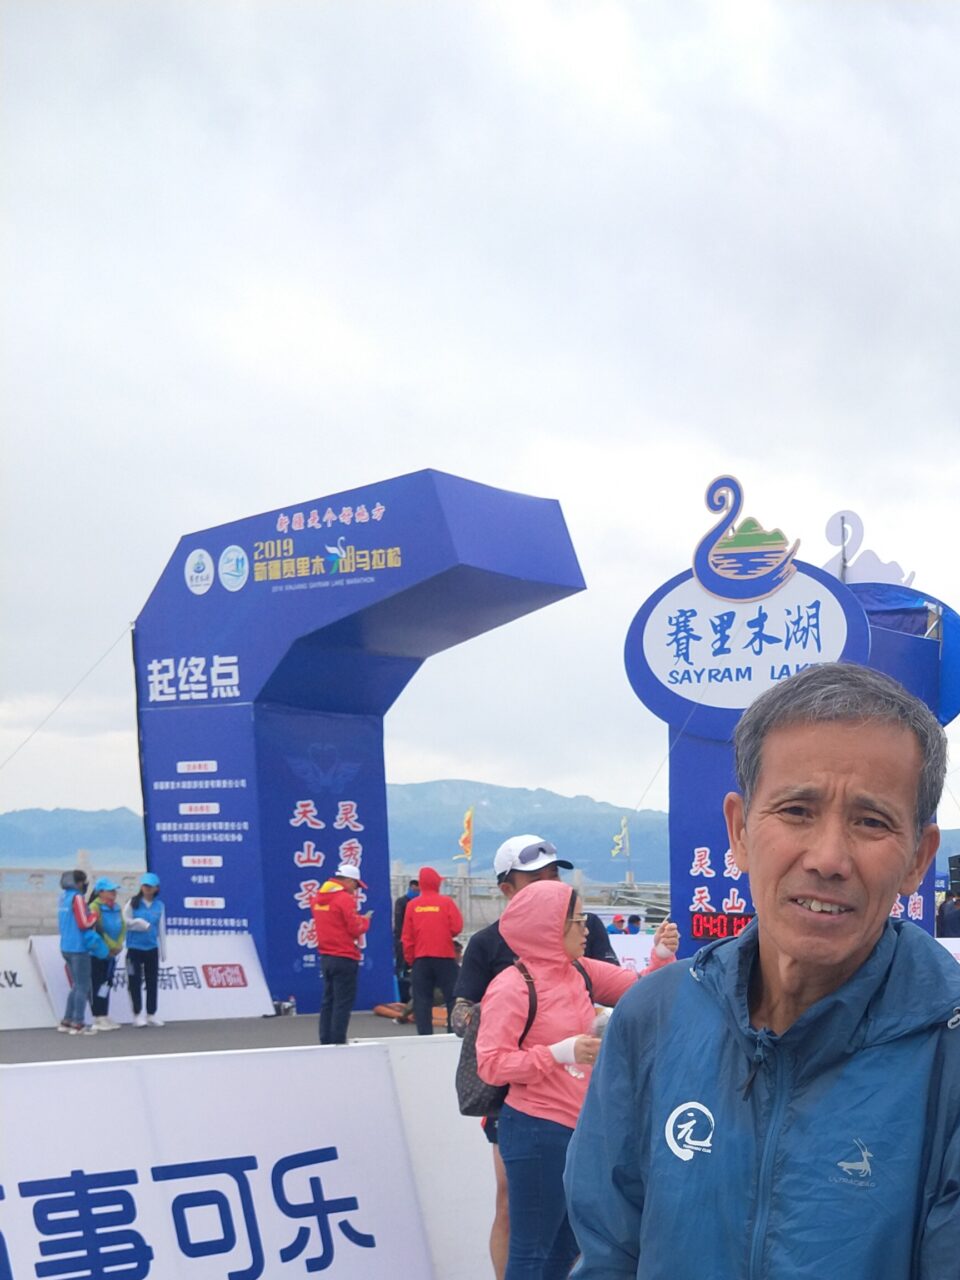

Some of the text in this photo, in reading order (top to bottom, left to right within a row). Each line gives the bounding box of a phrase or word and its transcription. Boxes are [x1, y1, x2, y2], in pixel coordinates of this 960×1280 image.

[253, 538, 294, 560] 2019
[147, 655, 241, 702] 起终点
[667, 662, 820, 685] SAYRAM LAK
